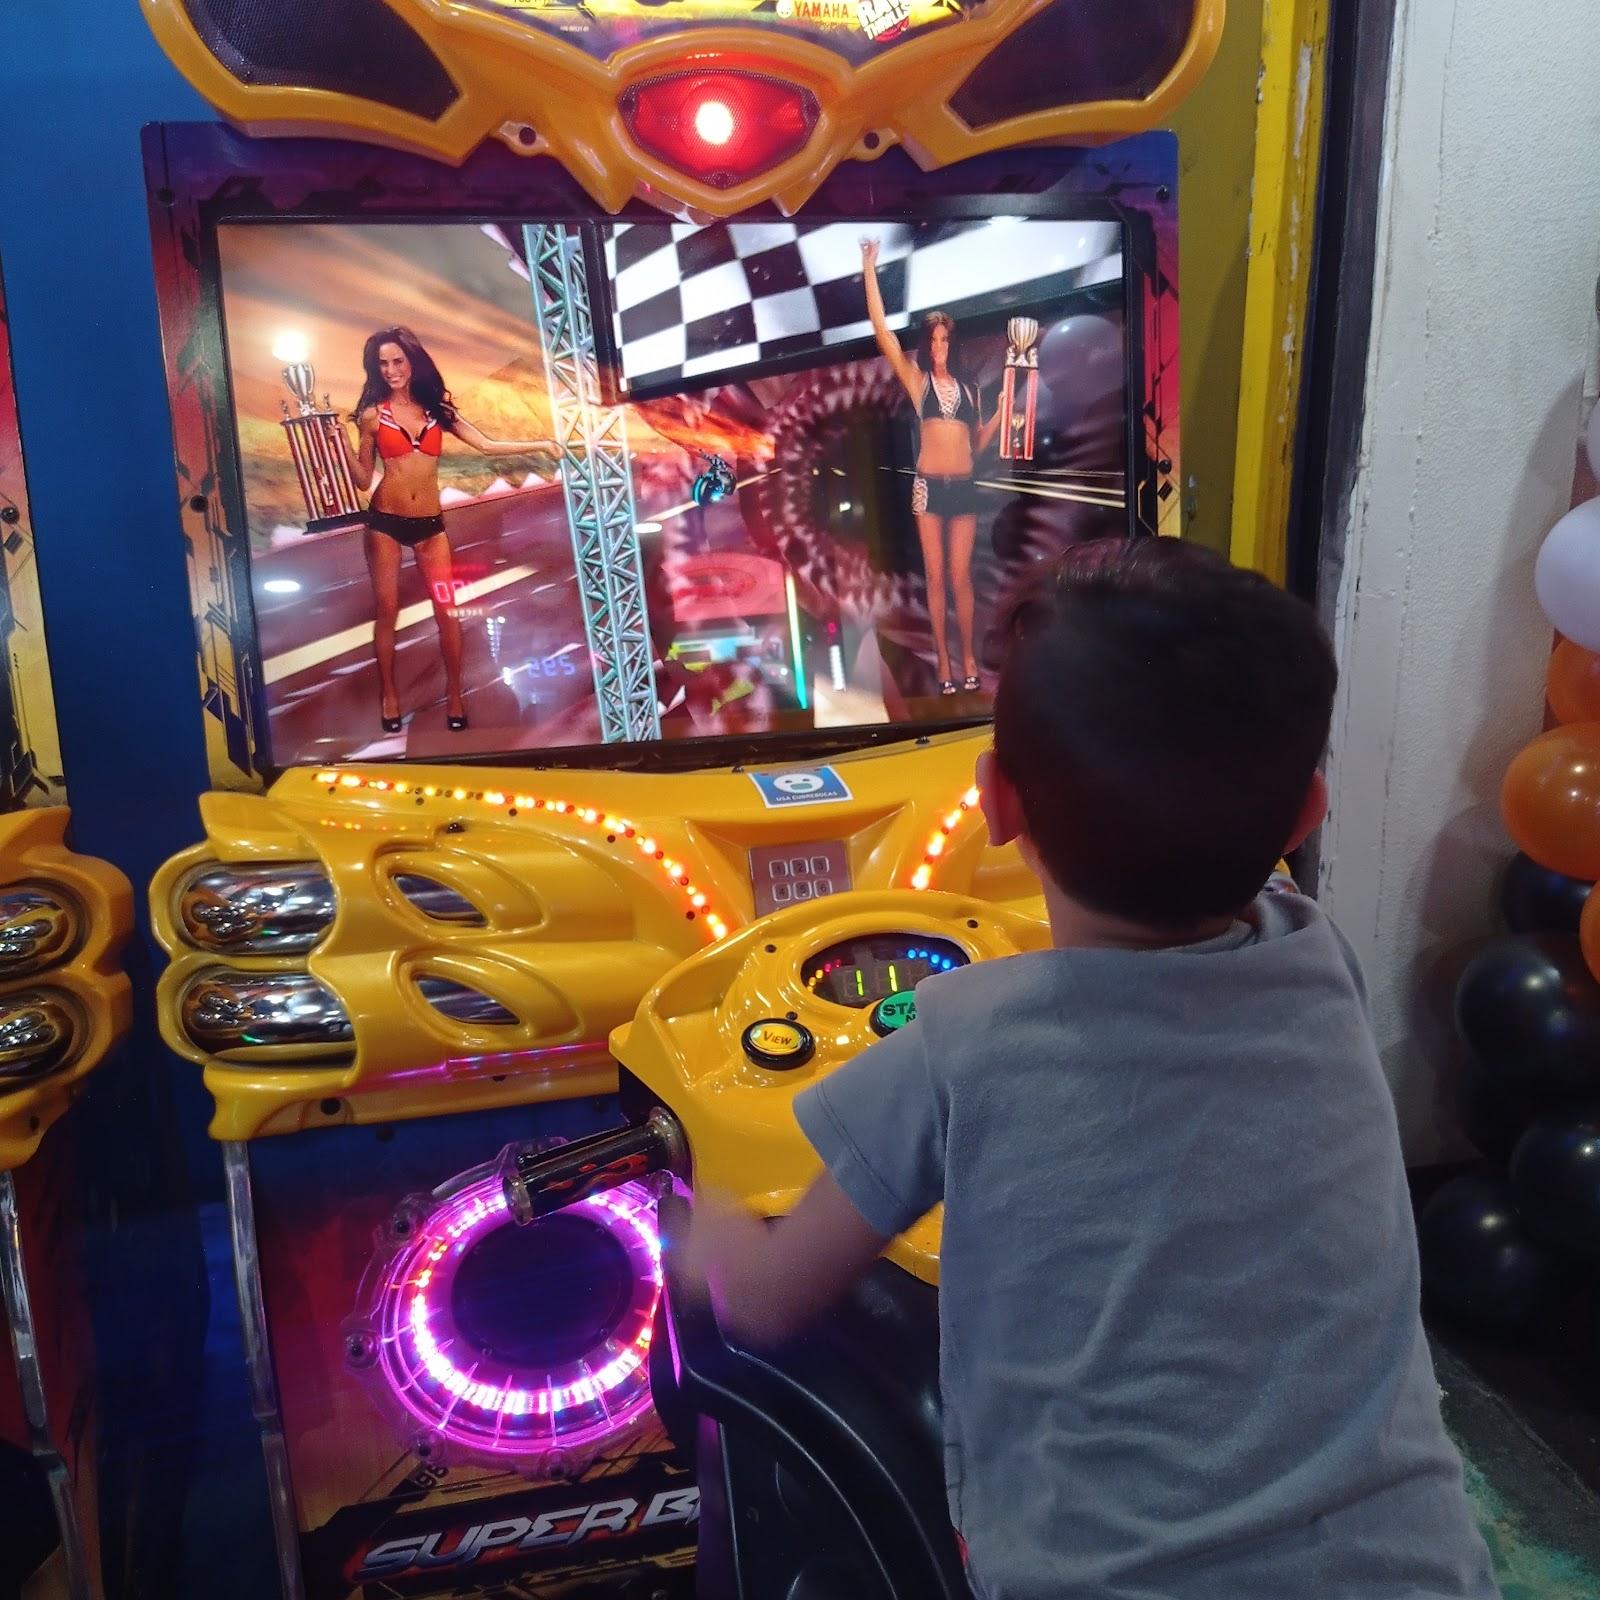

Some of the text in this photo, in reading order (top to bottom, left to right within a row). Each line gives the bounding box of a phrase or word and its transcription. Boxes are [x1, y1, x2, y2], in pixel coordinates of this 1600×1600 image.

[794, 3, 849, 17] YAMAHA
[354, 1486, 701, 1573] SUPER B
